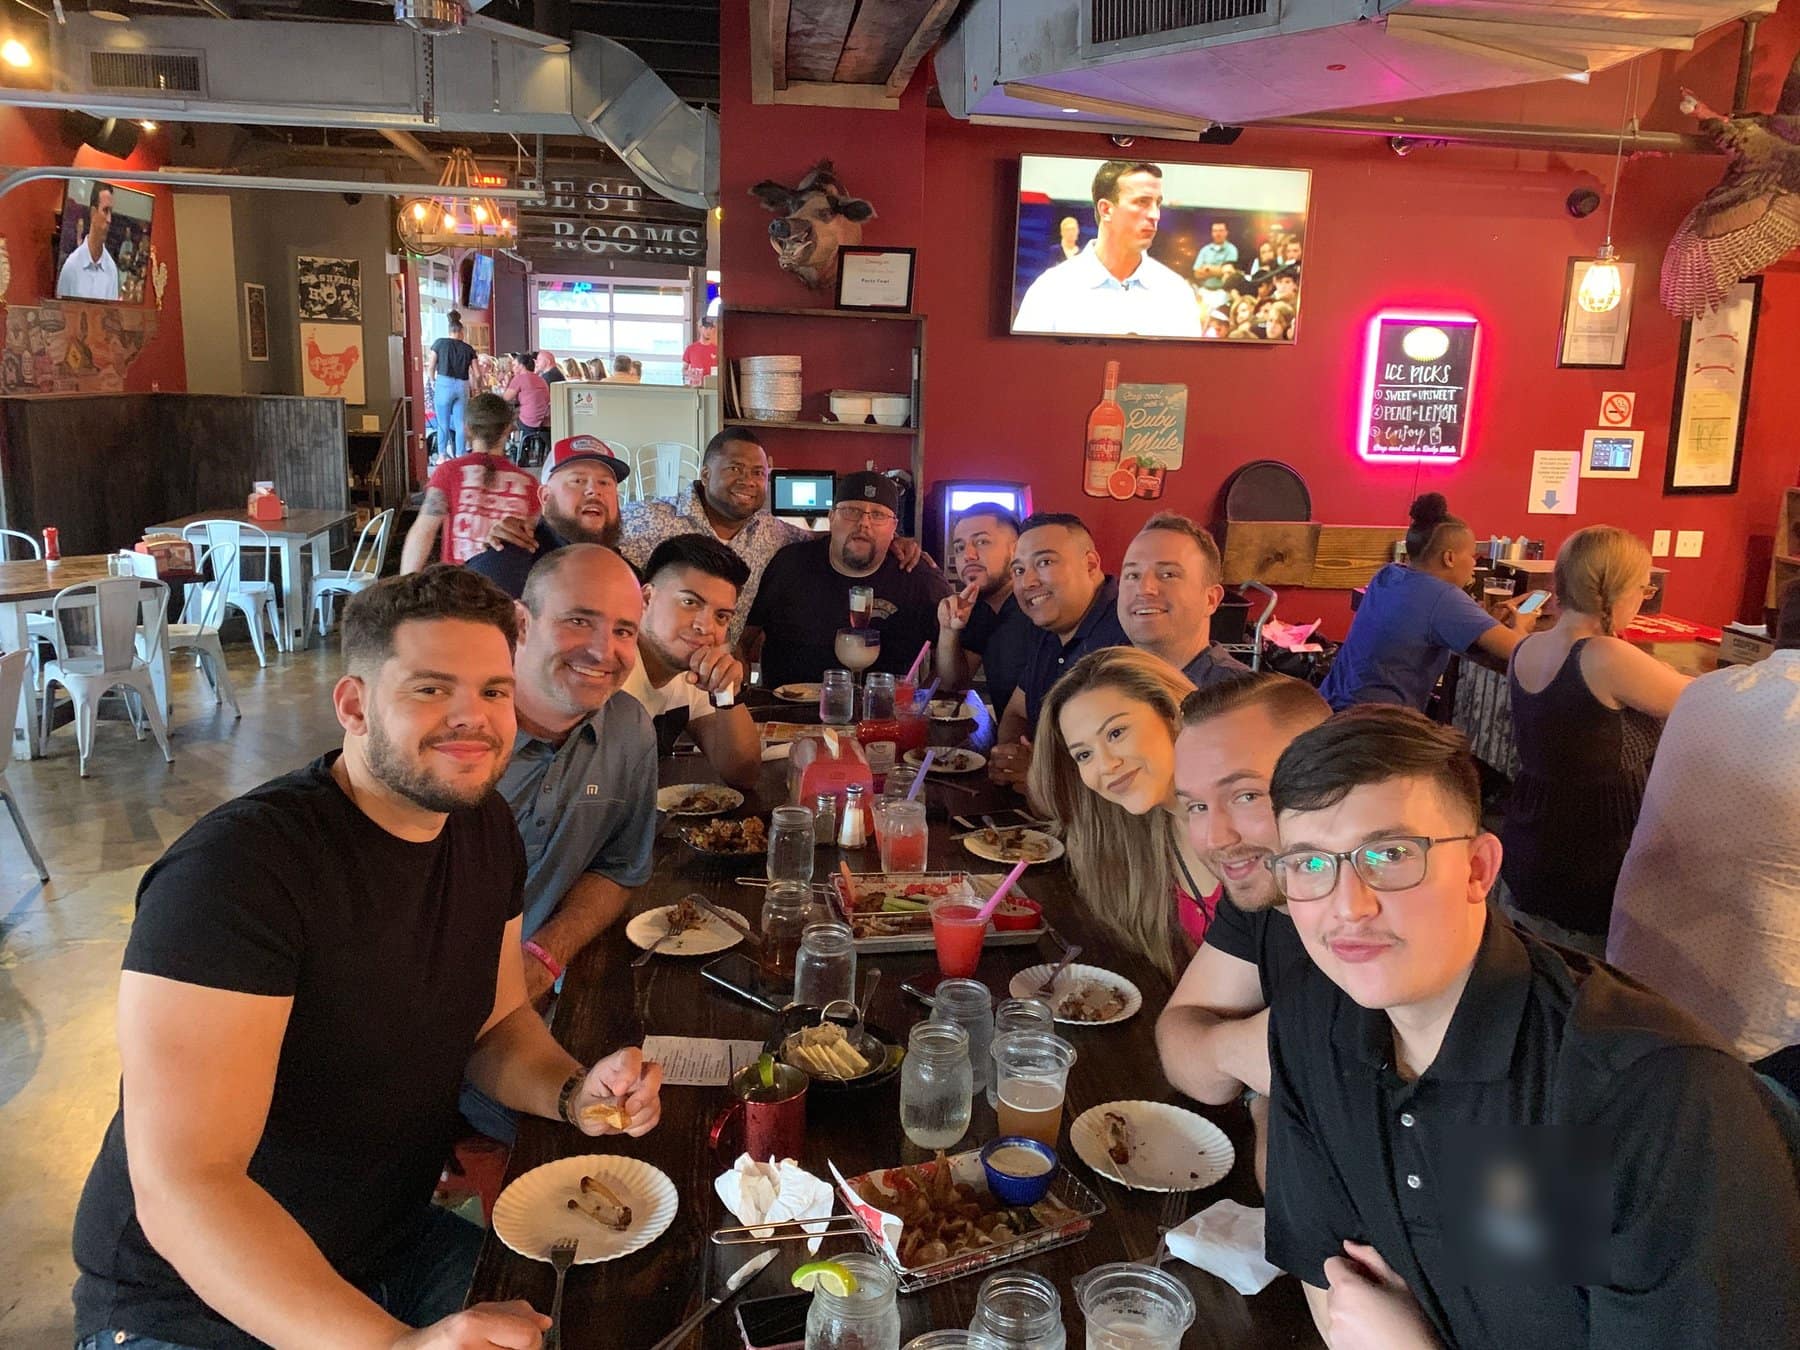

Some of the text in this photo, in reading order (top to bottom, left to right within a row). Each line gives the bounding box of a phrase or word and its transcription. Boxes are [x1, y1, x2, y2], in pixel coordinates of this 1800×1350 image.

[522, 180, 642, 212] REST
[552, 222, 698, 256] ROOMS
[1385, 363, 1451, 383] ICE PICKS
[1384, 390, 1412, 401] SWEET
[1418, 389, 1457, 401] UNSWEET
[1126, 407, 1177, 435] Ruby
[1384, 405, 1412, 422] PEACH
[1418, 404, 1458, 424] LEMON
[1128, 430, 1180, 452] Mule
